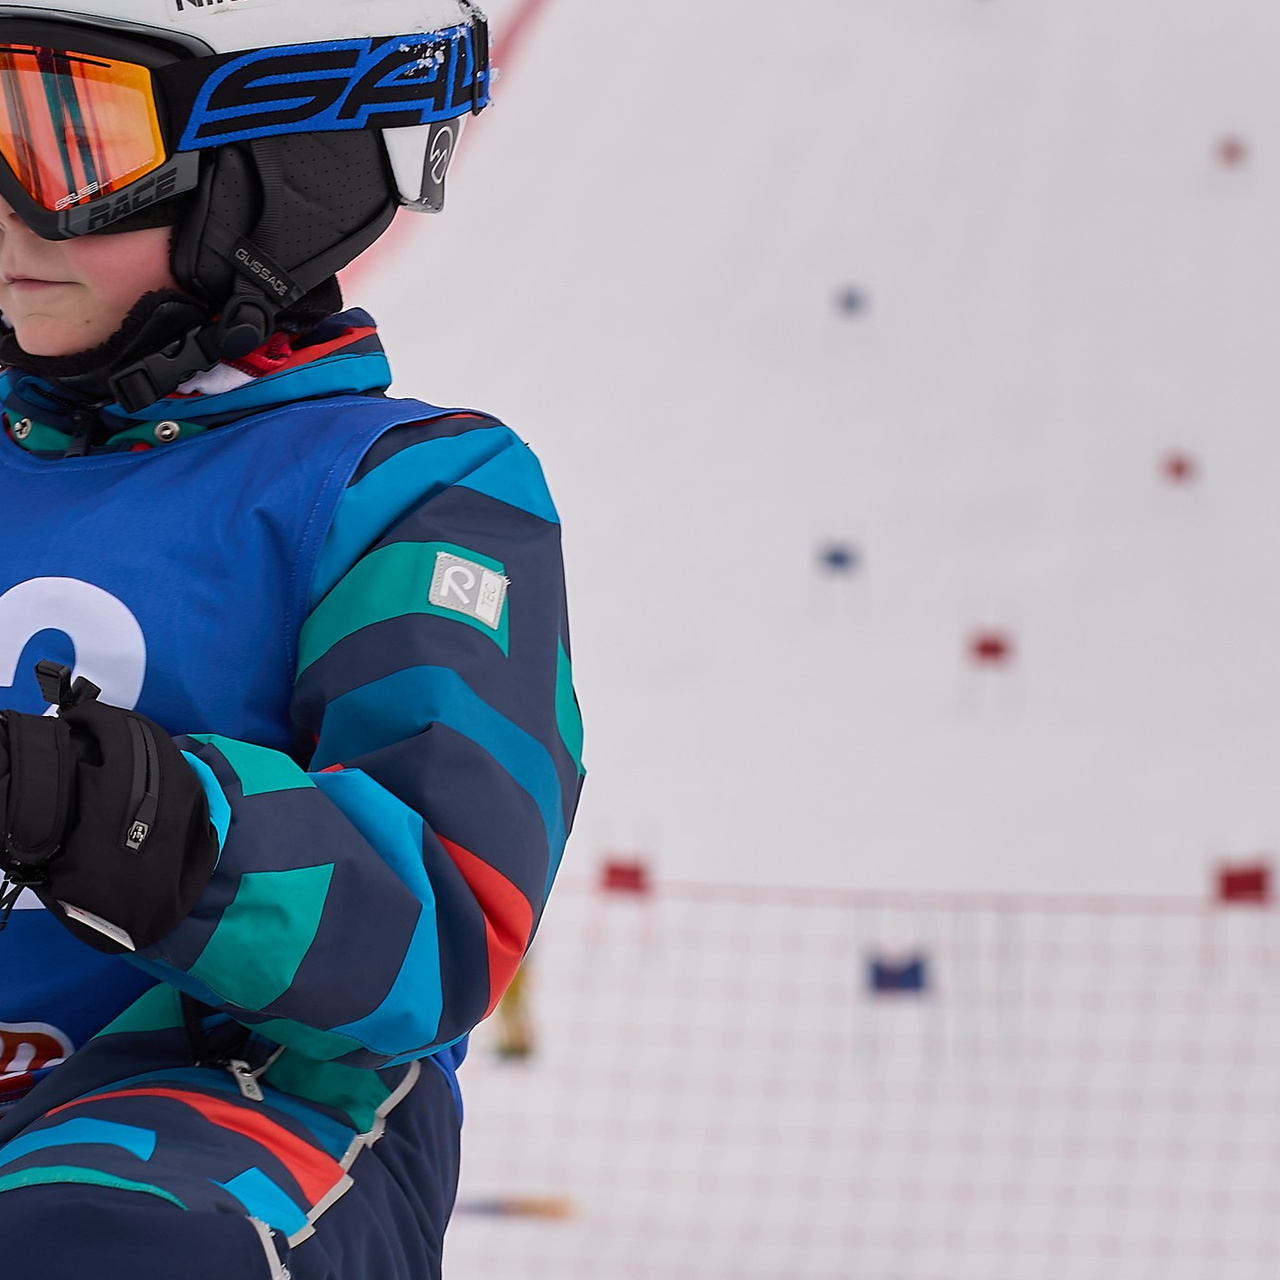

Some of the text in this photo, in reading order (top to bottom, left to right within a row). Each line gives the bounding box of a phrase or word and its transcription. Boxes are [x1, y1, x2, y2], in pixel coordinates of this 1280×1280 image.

[87, 166, 179, 231] RACE
[234, 247, 289, 297] GLISSADE
[439, 565, 476, 605] R
